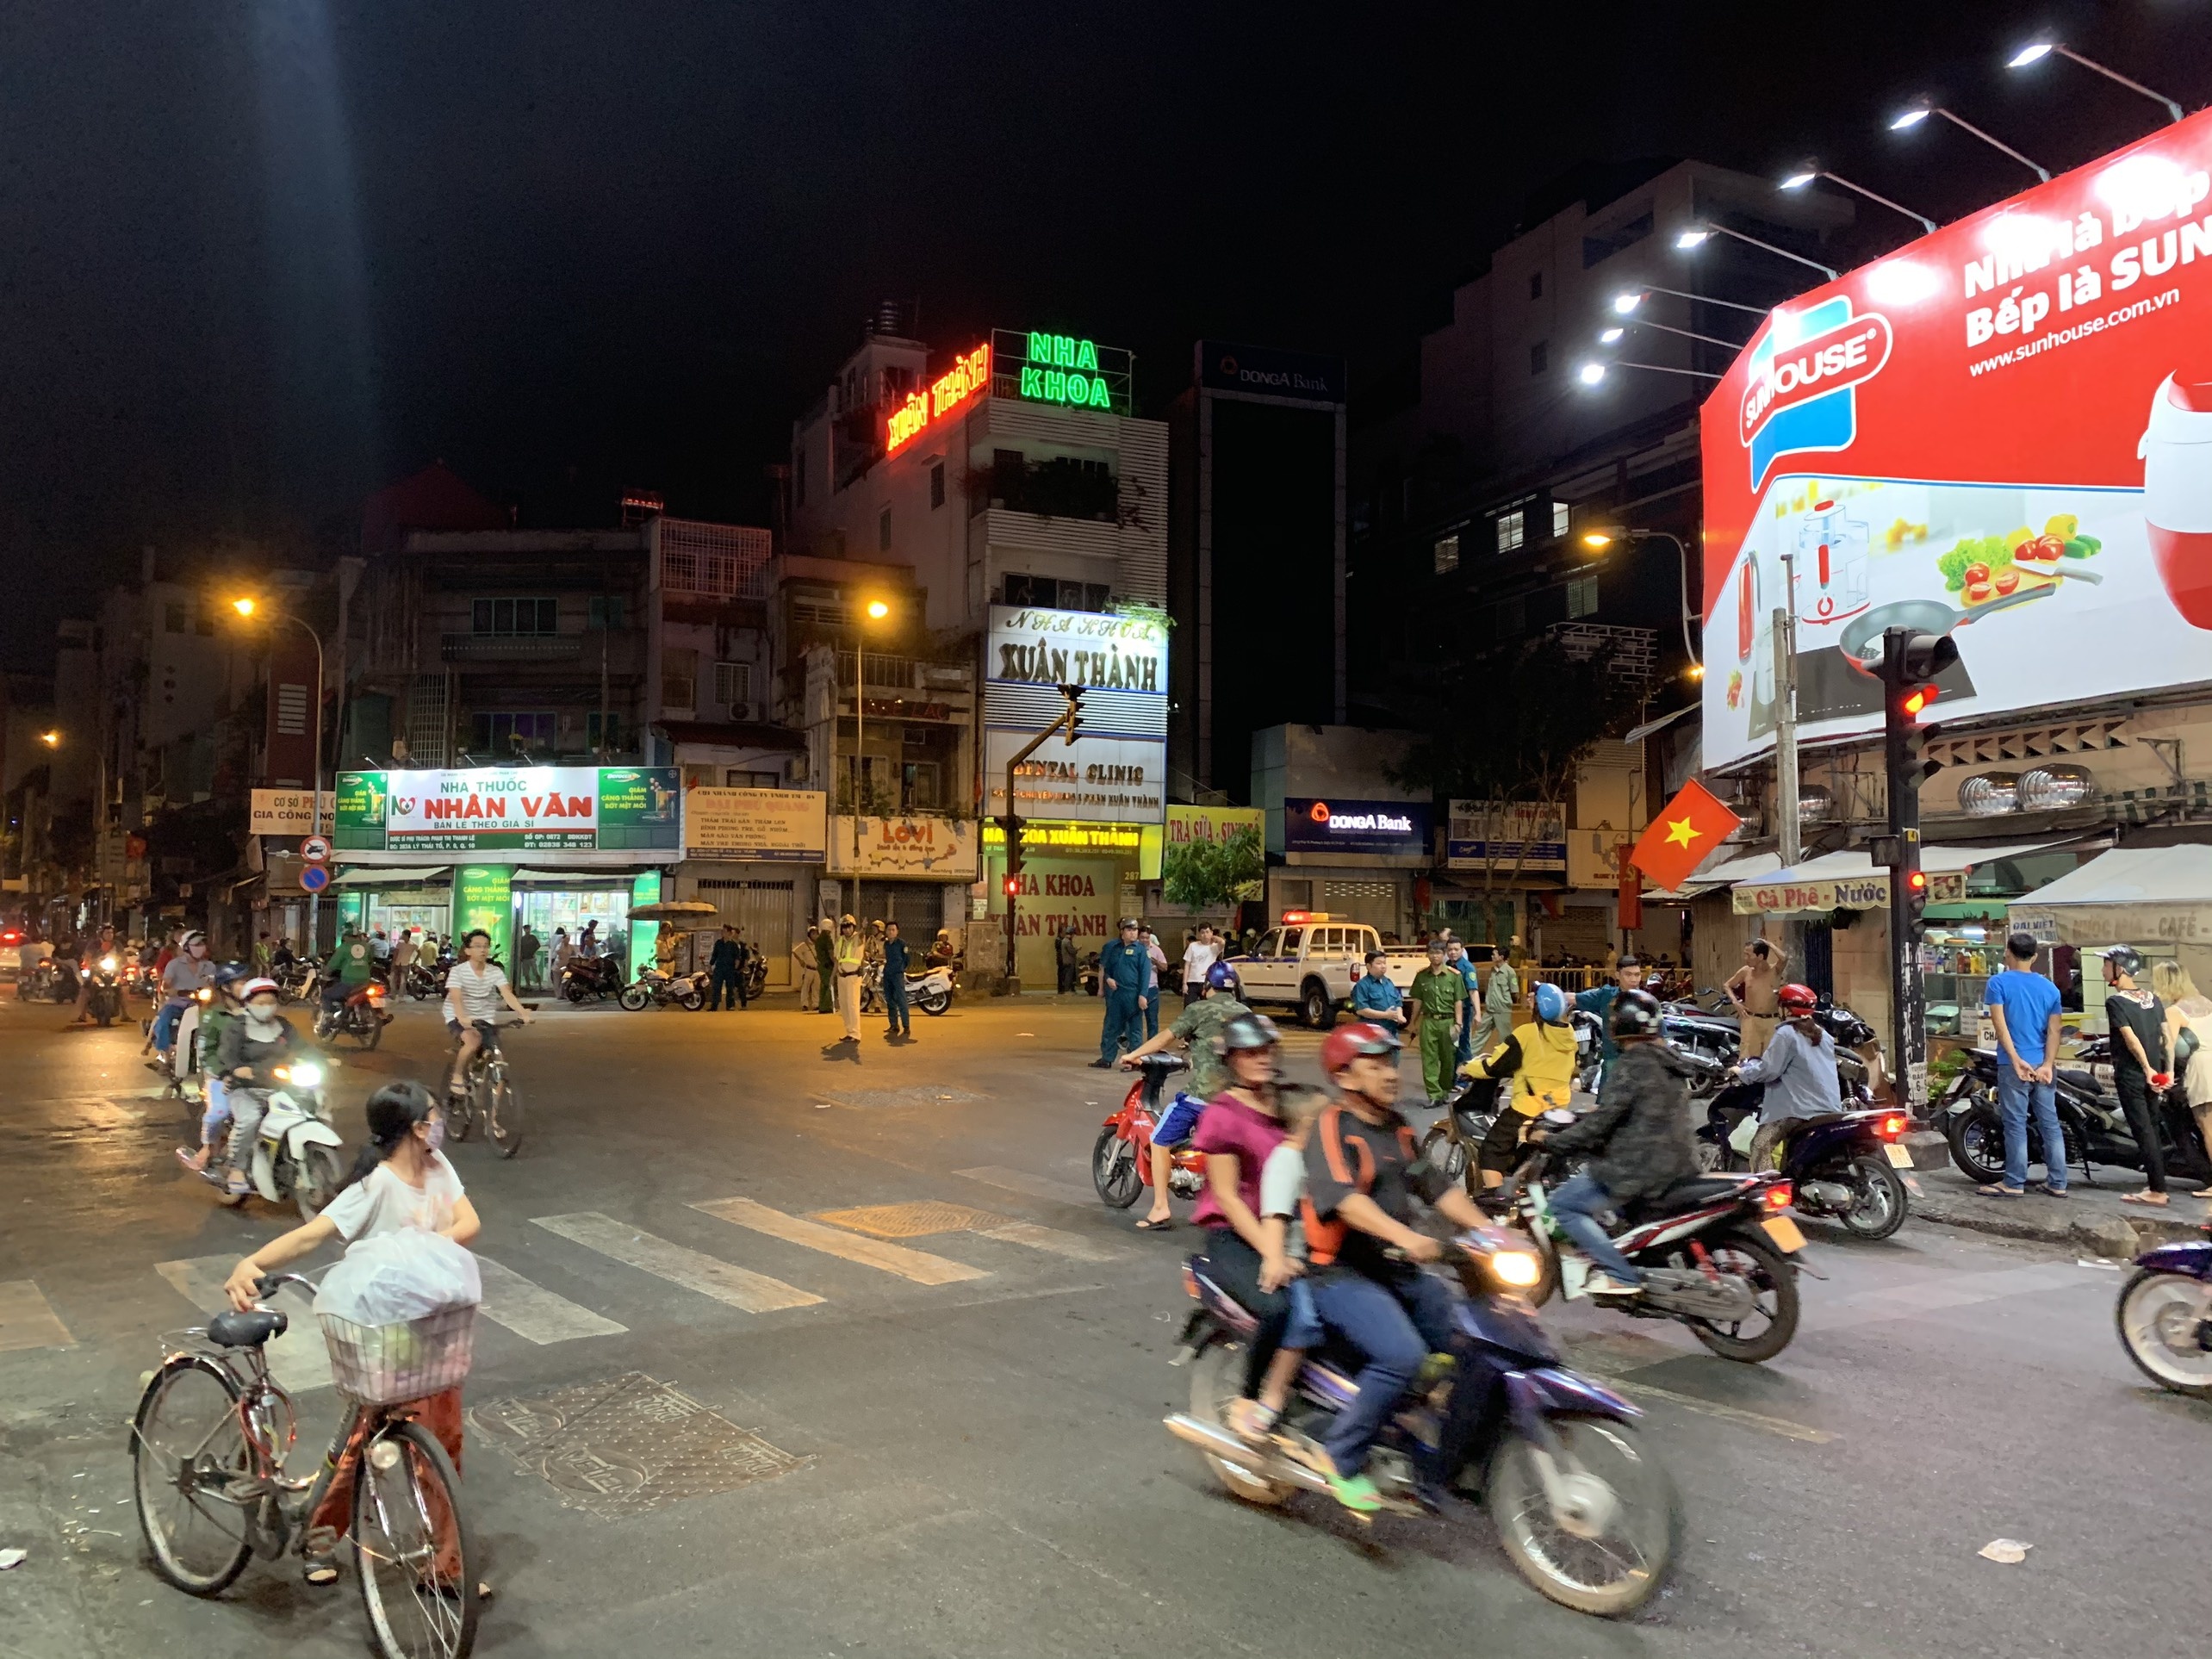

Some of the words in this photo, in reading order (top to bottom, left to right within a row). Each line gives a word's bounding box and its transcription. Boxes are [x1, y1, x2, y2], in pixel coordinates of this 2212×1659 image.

[1965, 286, 2050, 348] Bếp
[2058, 264, 2102, 313] là
[1969, 289, 2180, 377] www.sunhouse.com.vn
[1030, 331, 1098, 370] NHA
[1021, 365, 1111, 407] KHOA
[1293, 373, 1329, 394] Bank
[1746, 332, 1868, 429] SUNHOUSE
[887, 390, 929, 452] XUÂN
[932, 343, 989, 418] THÀNH
[1006, 611, 1075, 633] NHA
[997, 636, 1069, 684] XUÂN
[1075, 643, 1158, 692] THÀNH
[440, 778, 469, 793] NHÀ
[476, 776, 527, 792] THUỐC
[1014, 760, 1078, 779] DENTAL
[1087, 762, 1144, 782] CLINIC
[424, 792, 506, 819] NHÂN
[520, 792, 593, 817] VĂN
[1109, 792, 1130, 804] XUÂN
[1132, 793, 1159, 805] THÀNH
[253, 811, 274, 819] GIA
[278, 808, 312, 820] CÔNG
[434, 819, 452, 829] BÁN
[472, 820, 498, 829] THEO
[1170, 813, 1191, 842] TRÀ
[1329, 814, 1376, 830] DONGA
[1377, 814, 1413, 832] Bank
[1049, 824, 1089, 845] XUÂN
[1089, 826, 1139, 847] THÀNH
[1045, 873, 1096, 897] KHOA
[1124, 871, 1140, 881] 287
[1756, 889, 1780, 910] Cà
[1784, 886, 1819, 908] Phê
[1834, 882, 1887, 904] Nước
[1045, 906, 1108, 936] THÀNH
[2159, 910, 2198, 937] CAFÉ
